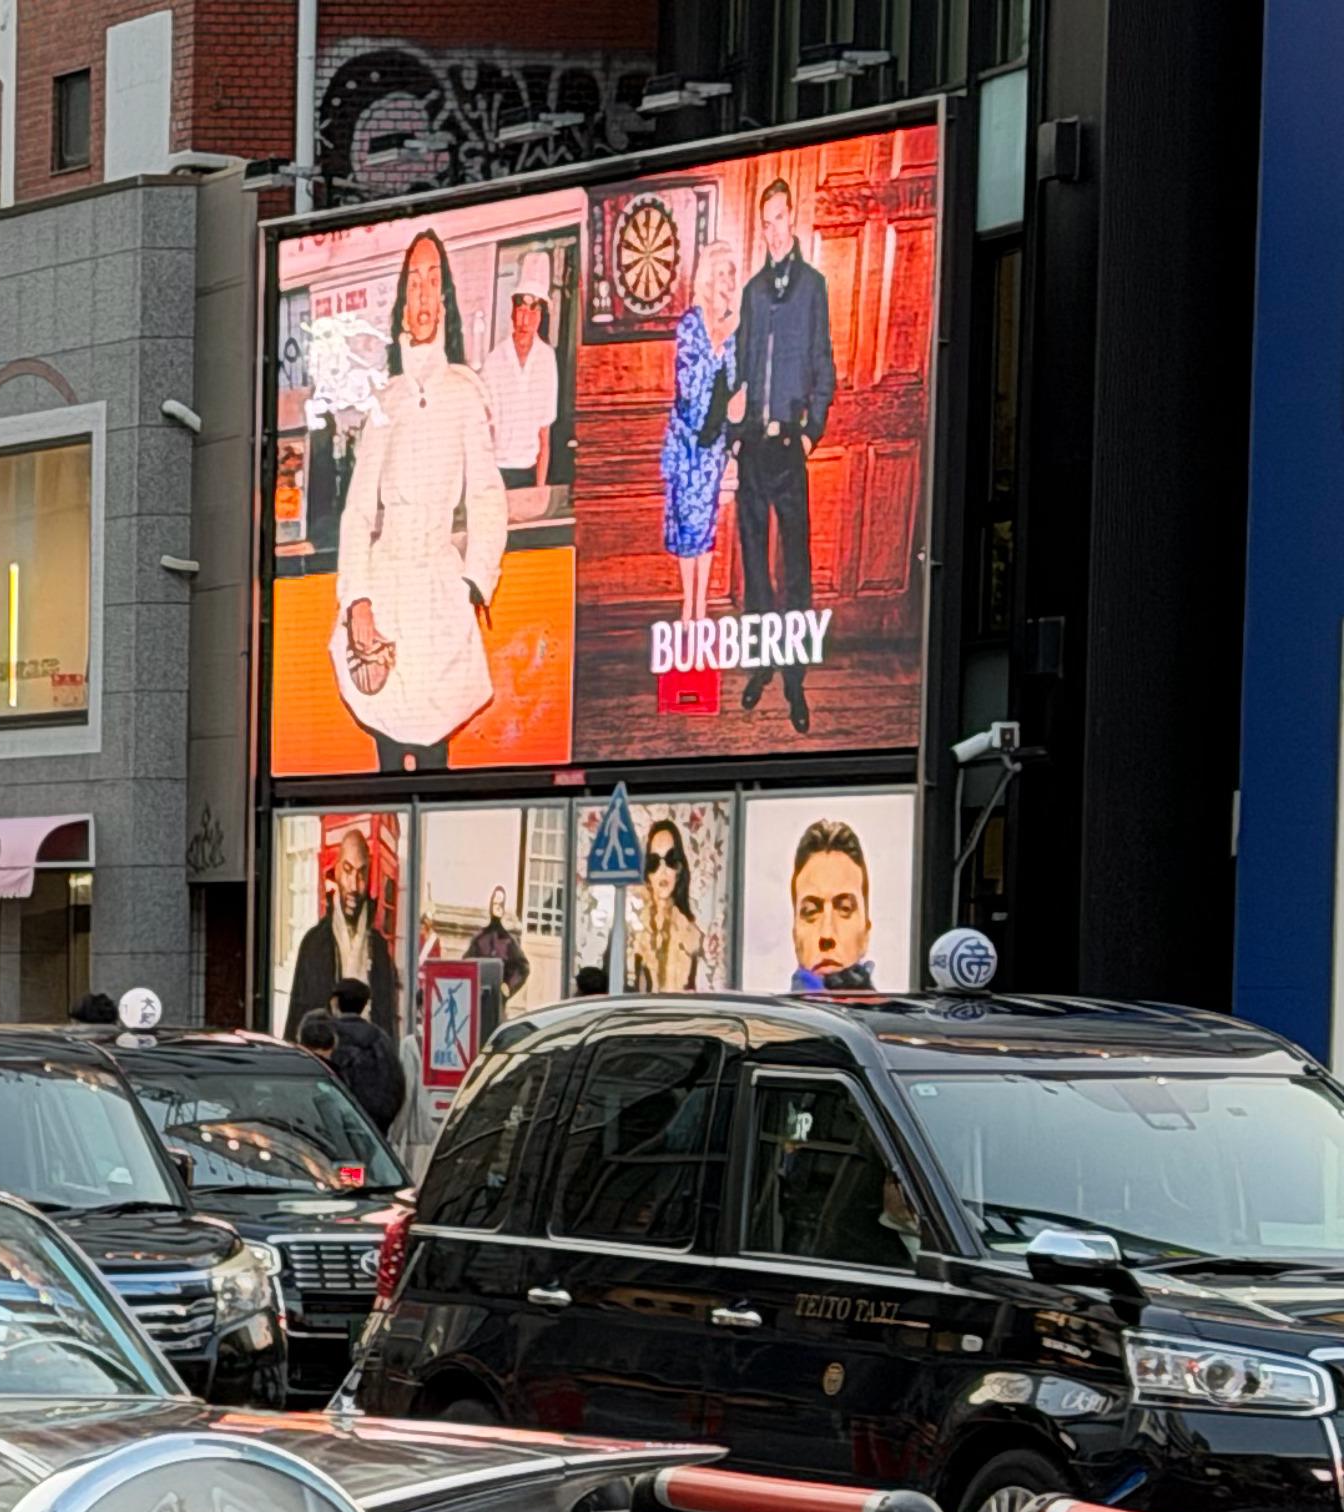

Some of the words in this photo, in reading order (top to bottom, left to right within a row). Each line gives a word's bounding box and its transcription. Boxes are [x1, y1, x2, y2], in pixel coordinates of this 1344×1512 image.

[651, 608, 833, 674] BURBERRY
[795, 1293, 852, 1320] TEITO
[854, 1298, 901, 1323] TAXI
